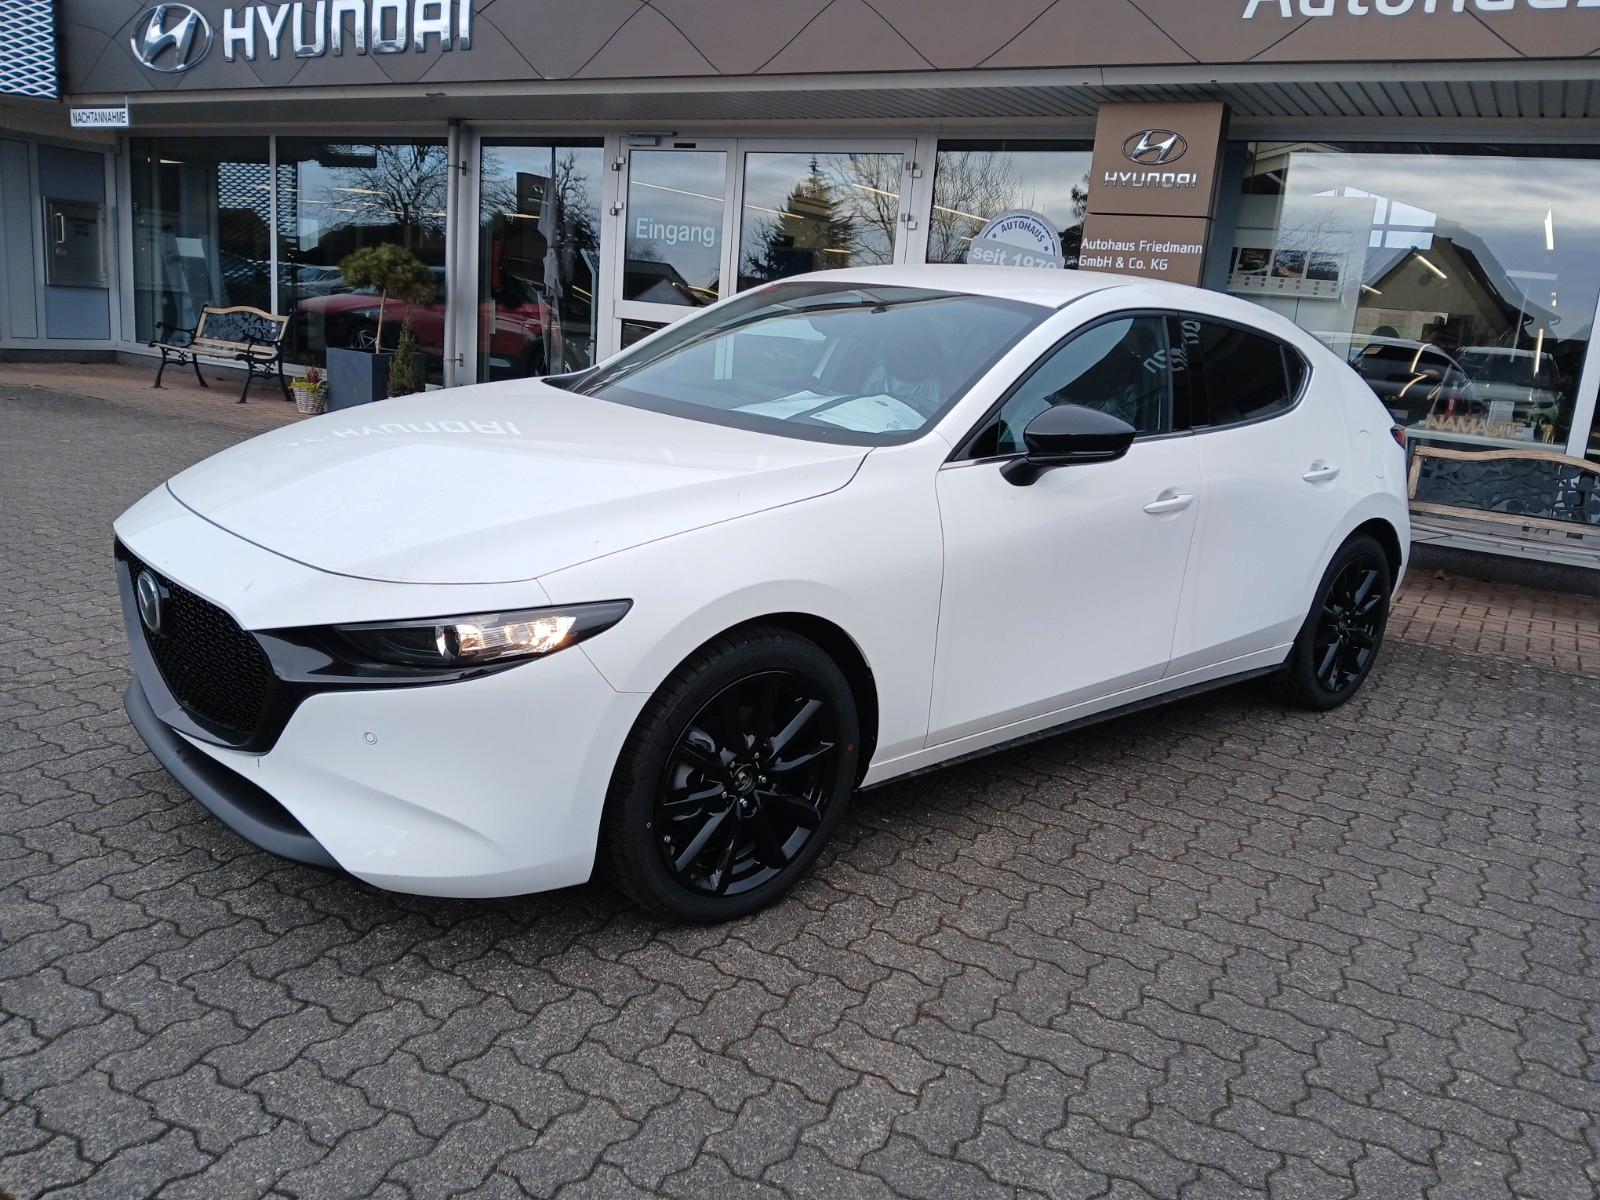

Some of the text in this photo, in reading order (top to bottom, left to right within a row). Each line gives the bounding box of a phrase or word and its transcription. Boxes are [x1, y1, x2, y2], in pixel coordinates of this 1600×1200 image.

[223, 0, 472, 62] HYUNDAI
[72, 111, 127, 124] NACHTANNAHME
[1104, 171, 1197, 188] HYUNDAI
[636, 217, 715, 248] Eingang
[1001, 220, 1046, 242] AUTOHAUS
[1080, 238, 1203, 255] Autohaus Friedmann
[1078, 255, 1169, 271] GmbH & Co. KG
